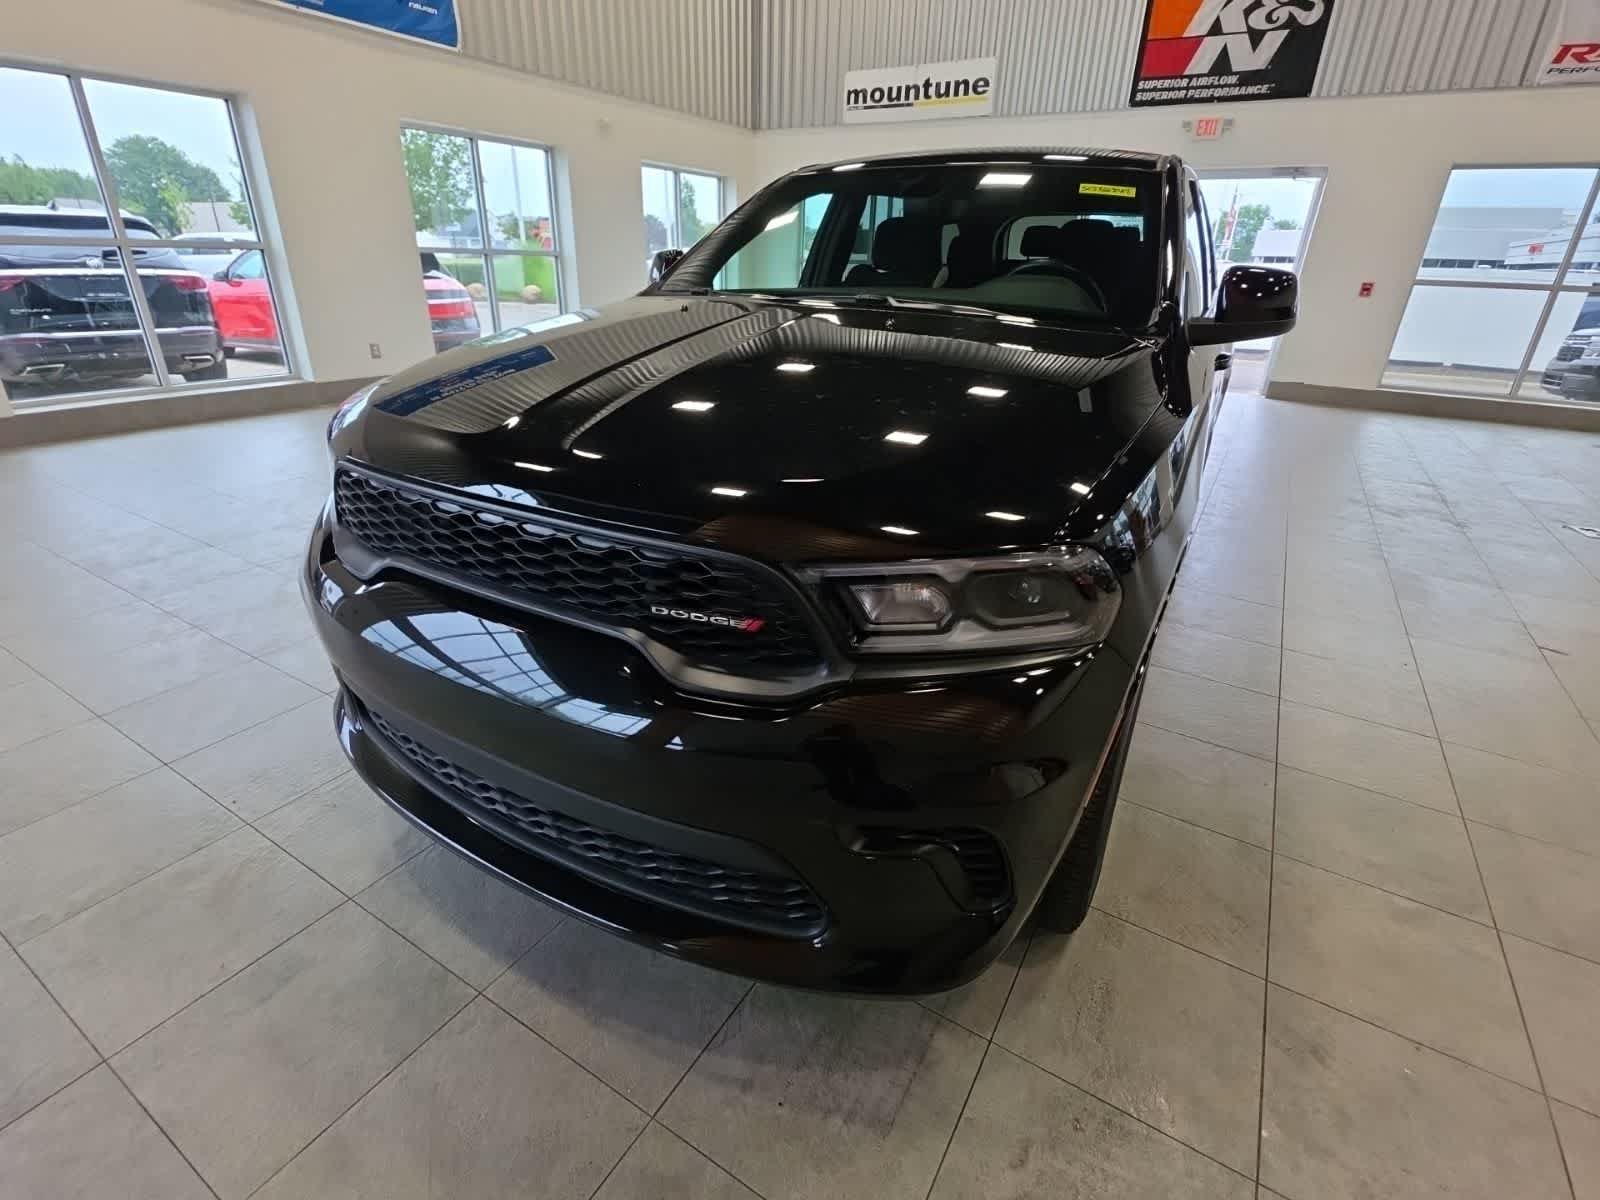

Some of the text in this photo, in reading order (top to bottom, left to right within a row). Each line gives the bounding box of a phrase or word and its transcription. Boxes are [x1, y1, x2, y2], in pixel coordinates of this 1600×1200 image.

[847, 76, 990, 105] mountune
[1137, 78, 1189, 90] SUPERIOR
[1135, 89, 1186, 101] SUPERIOR
[1196, 119, 1218, 137] EXIT
[652, 605, 747, 628] DODGE
